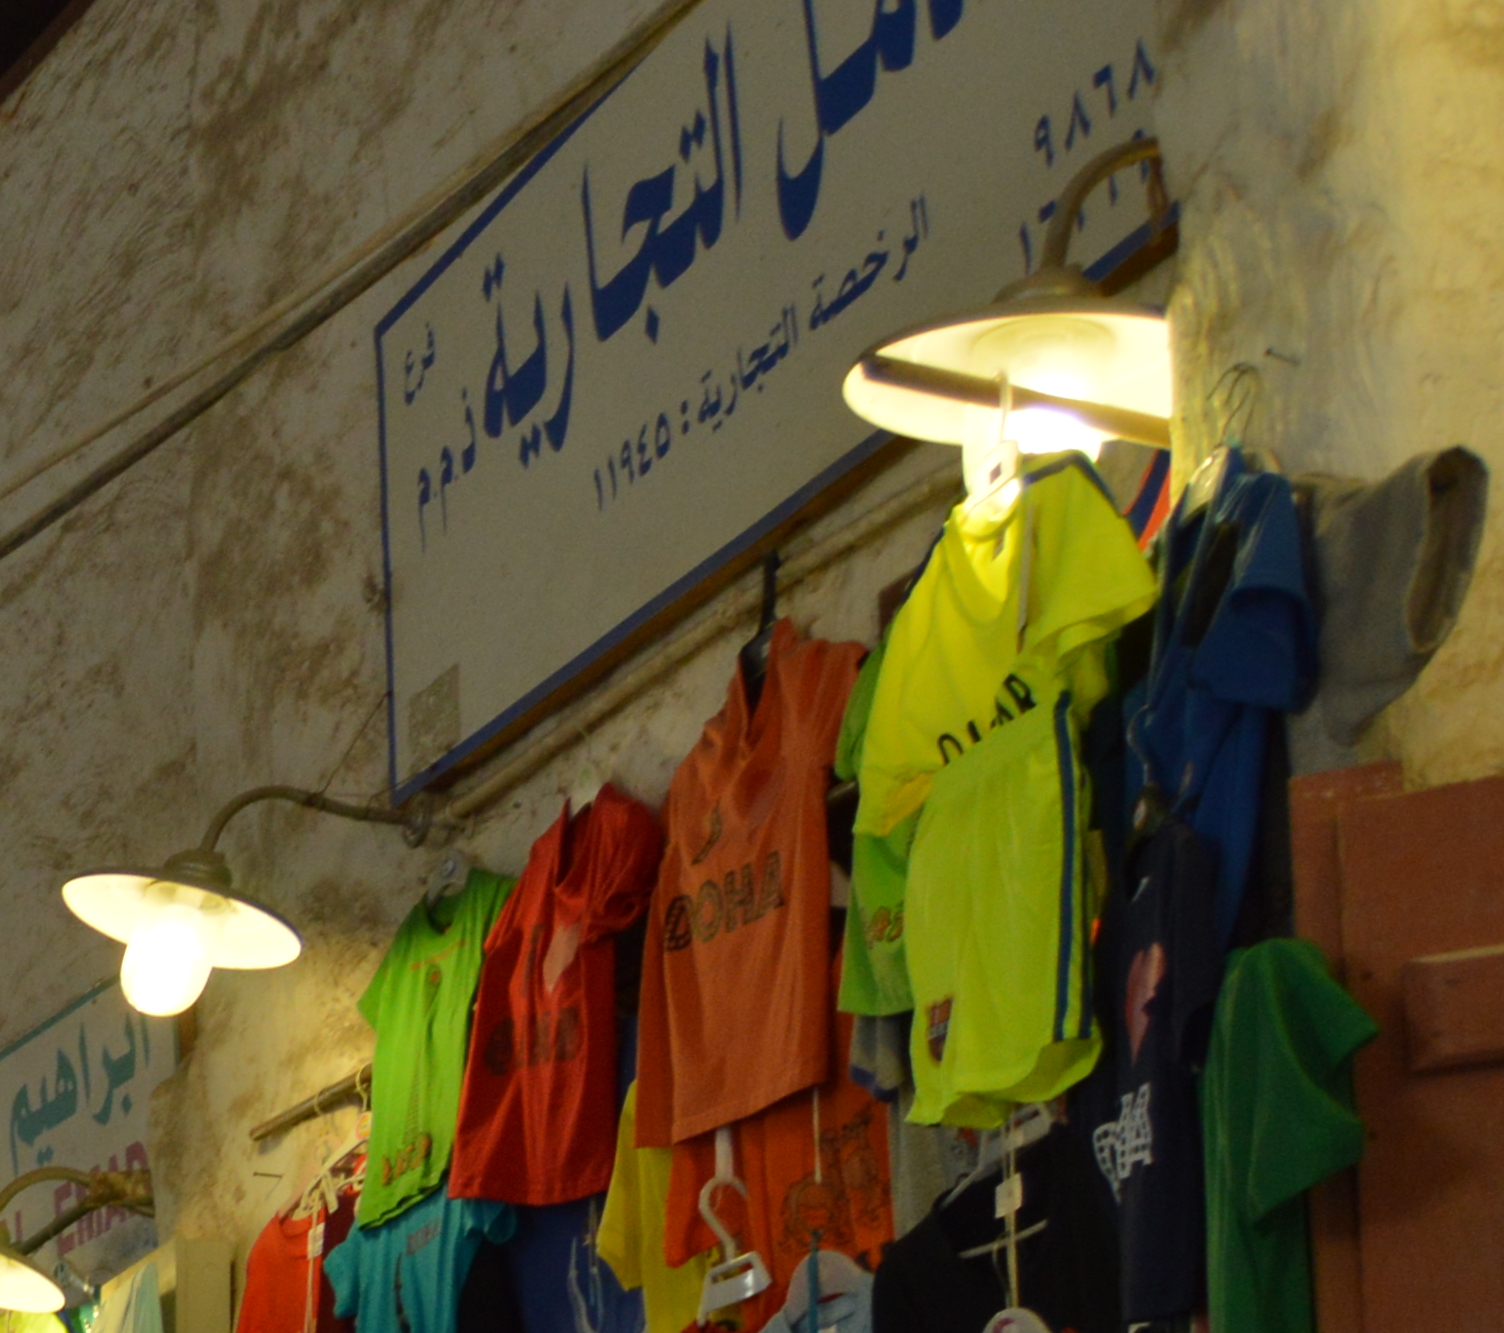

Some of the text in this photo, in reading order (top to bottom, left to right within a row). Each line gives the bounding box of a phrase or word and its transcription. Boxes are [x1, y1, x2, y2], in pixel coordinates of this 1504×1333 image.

[483, 21, 743, 471] التجارية
[809, 194, 930, 331] الرخصة
[698, 302, 798, 433] التجارية
[594, 412, 672, 512] ١١٩٤٥
[664, 850, 785, 953] DOHA
